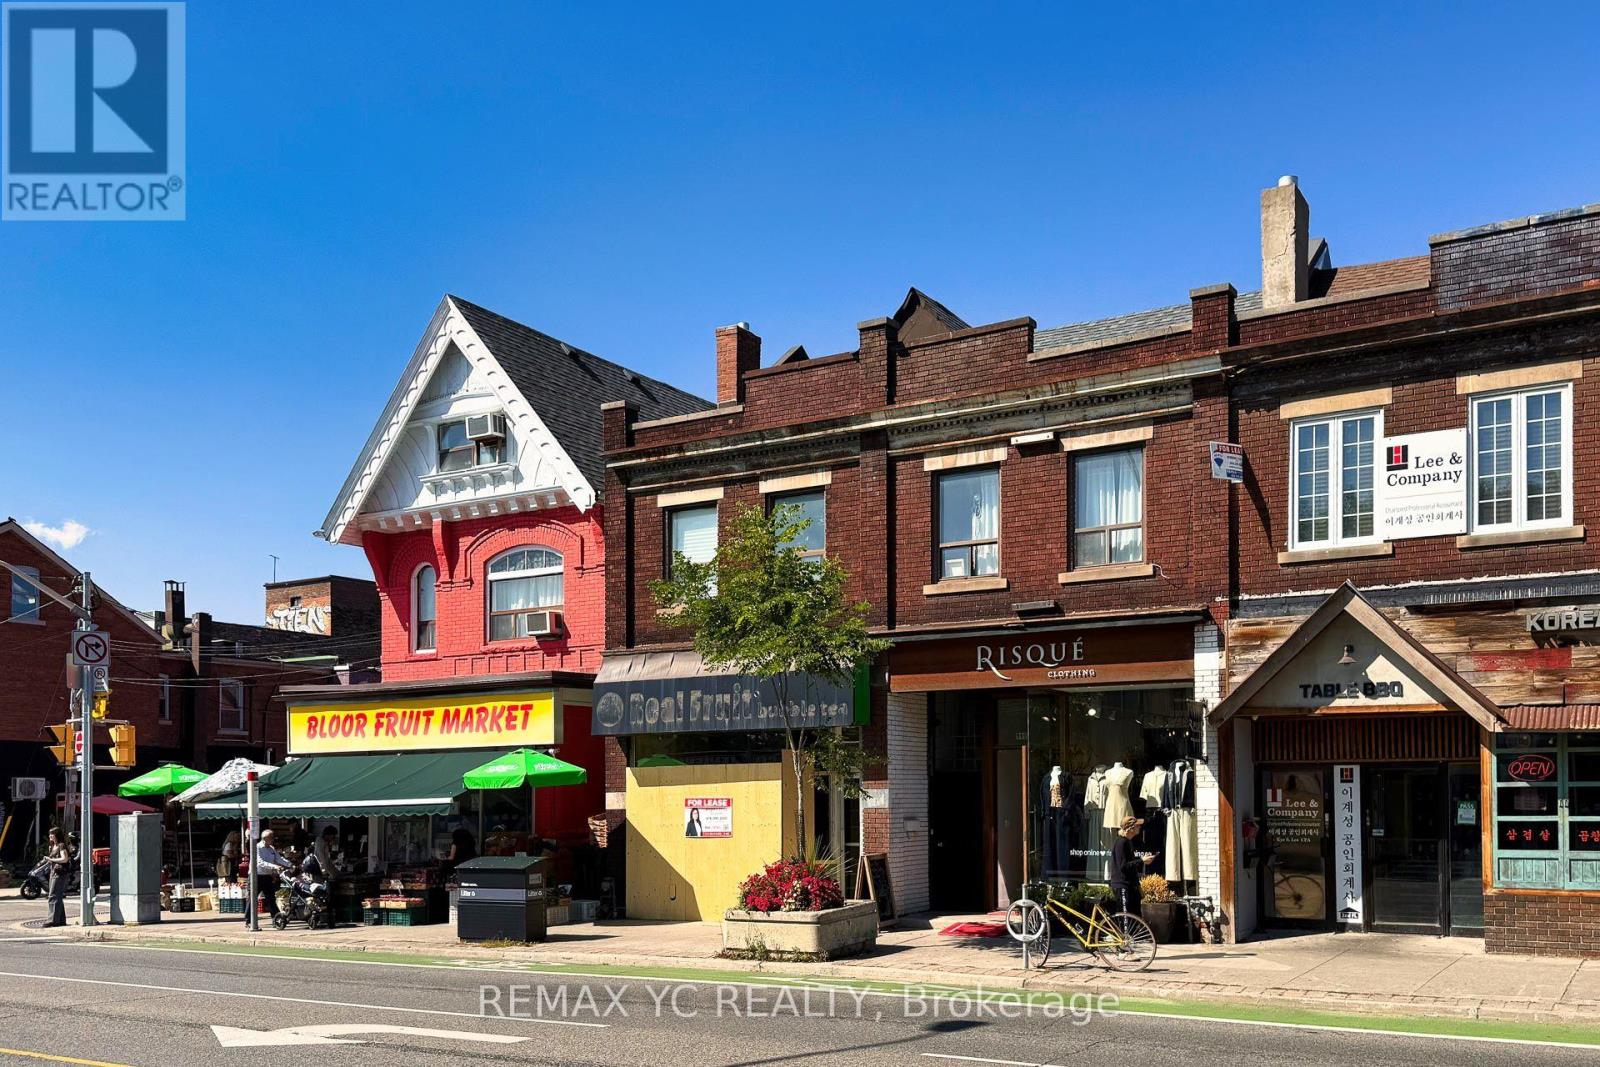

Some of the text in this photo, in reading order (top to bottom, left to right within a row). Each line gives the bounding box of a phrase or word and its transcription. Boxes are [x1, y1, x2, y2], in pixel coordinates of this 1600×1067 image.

[1414, 452, 1463, 469] Lee &
[1387, 470, 1463, 486] Company
[976, 636, 1084, 681] RISQUÉ
[1047, 669, 1096, 678] CLOTHING
[1299, 681, 1404, 699] TABLE BBQ
[689, 682, 752, 721] Fruit
[821, 701, 848, 717] tea
[306, 704, 534, 739] BLOOR FRUIT MARKET
[1510, 761, 1550, 775] OPEN
[704, 799, 728, 807] LEASE
[1286, 799, 1319, 808] Lee &
[1267, 808, 1319, 819] Company
[1070, 849, 1083, 858] shop
[1084, 849, 1099, 857] online
[1342, 833, 1355, 904] 공인회계사
